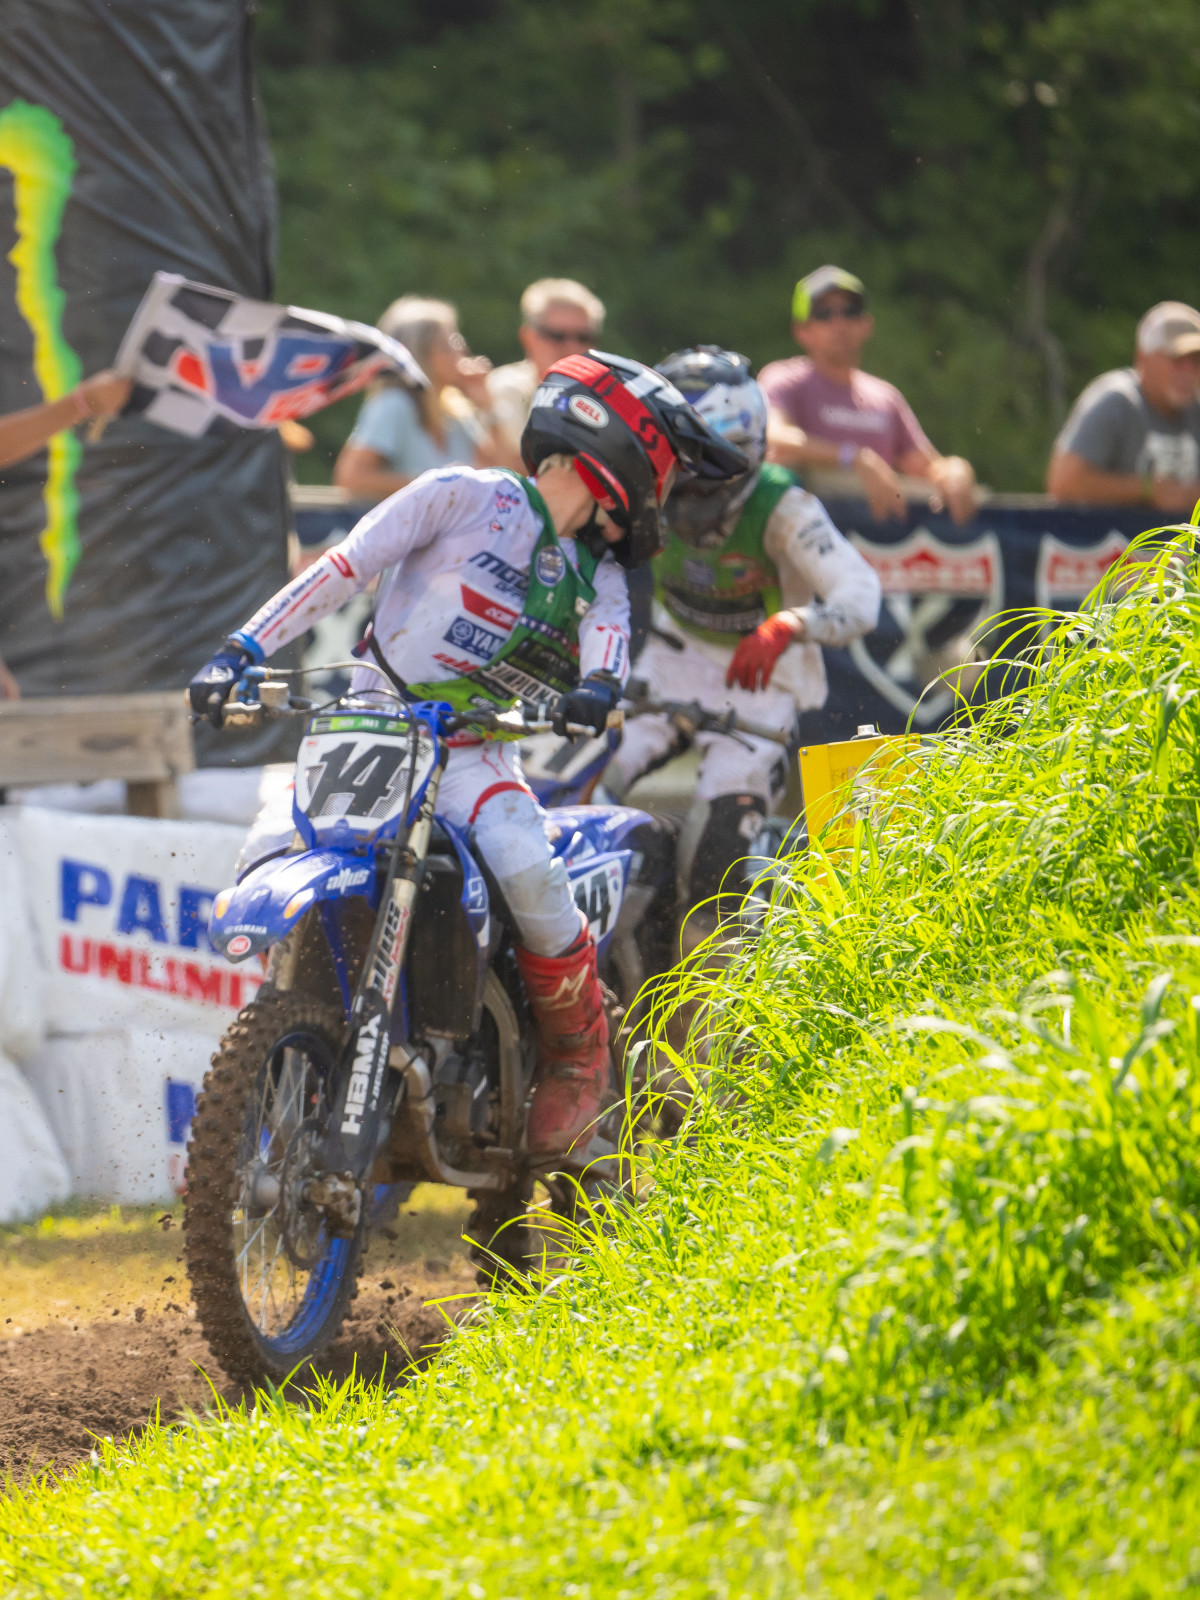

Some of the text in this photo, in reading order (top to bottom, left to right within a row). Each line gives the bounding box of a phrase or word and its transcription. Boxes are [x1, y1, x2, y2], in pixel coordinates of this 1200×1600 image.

[575, 399, 602, 422] BELL
[305, 740, 409, 819] 14
[233, 924, 268, 935] YAMAHA
[341, 1013, 382, 1136] HBMX
